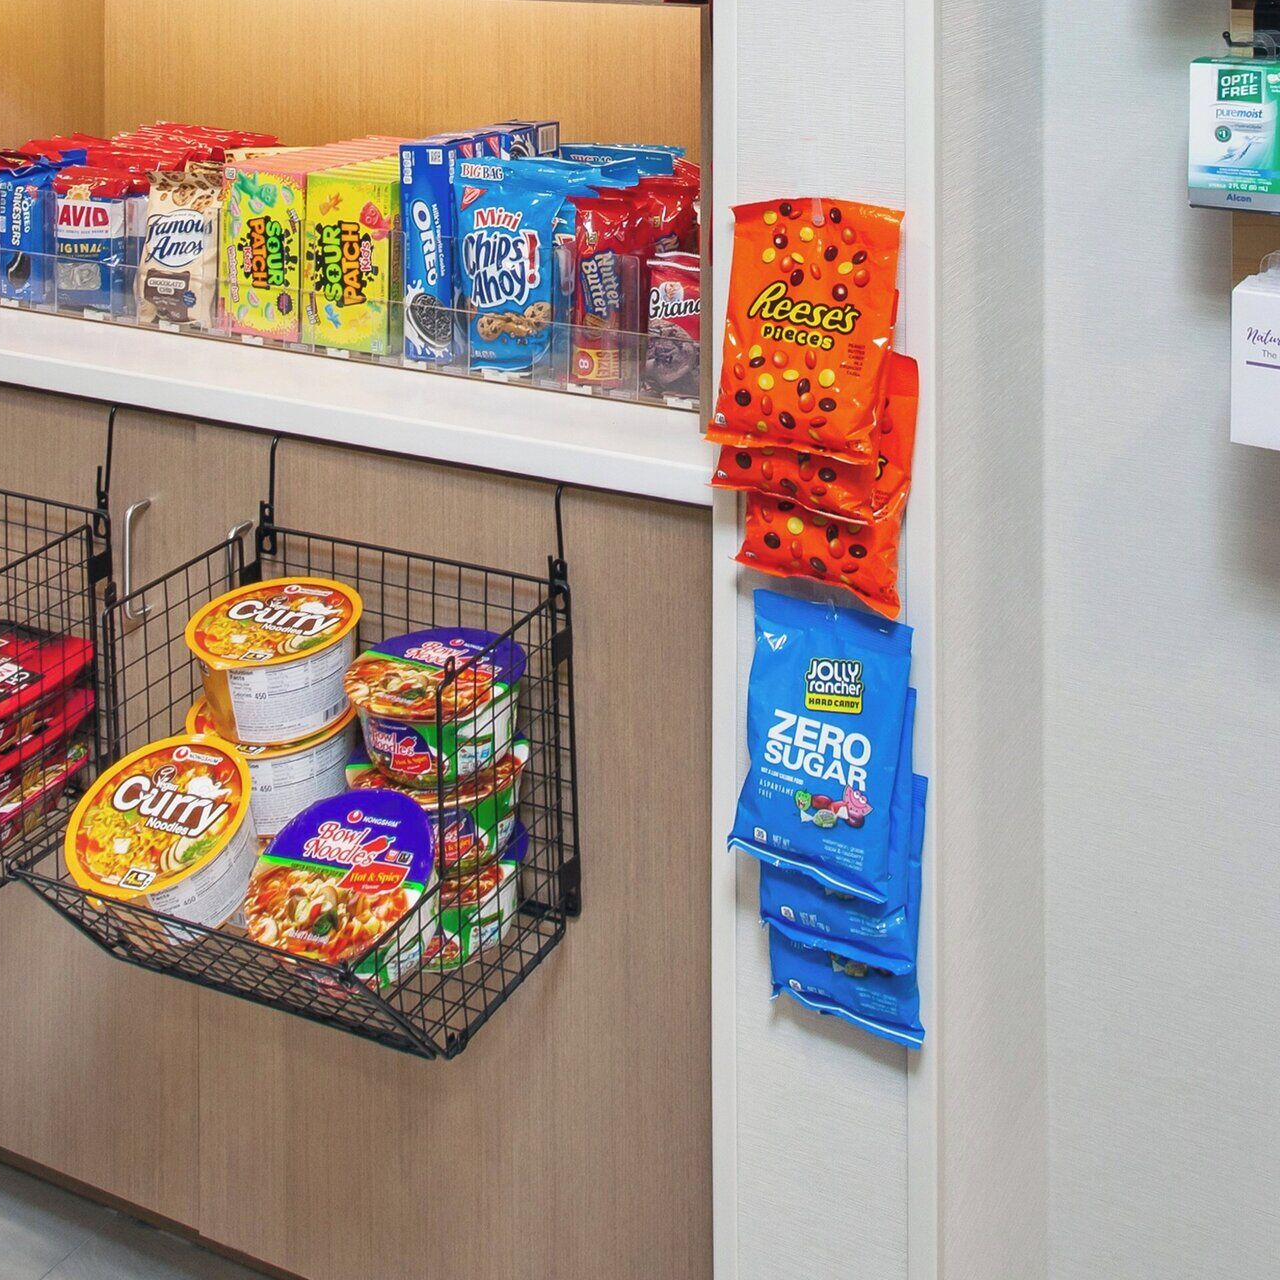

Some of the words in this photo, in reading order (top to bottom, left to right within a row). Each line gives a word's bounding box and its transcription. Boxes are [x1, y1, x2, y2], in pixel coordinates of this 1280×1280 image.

[1221, 73, 1257, 86] OPTI-
[1221, 85, 1258, 97] FREE
[1216, 109, 1262, 118] puremoist
[460, 163, 481, 178] BIG
[481, 163, 504, 180] BAG
[1226, 194, 1252, 202] Alcon
[473, 208, 522, 231] Mini
[145, 236, 203, 263] Amos
[249, 217, 270, 290] PATCH
[266, 219, 284, 286] SOUR
[411, 201, 438, 287] OREO
[463, 231, 527, 276] Chips
[324, 224, 343, 303] SOUR
[343, 221, 363, 307] PATCH
[749, 282, 860, 334] Reese's
[1262, 349, 1276, 359] The
[228, 599, 342, 637] Curry
[807, 659, 861, 682] JOLLY
[255, 692, 267, 700] 450
[808, 678, 862, 698] rancher
[808, 697, 833, 708] HARD
[833, 698, 861, 709] CANDY
[767, 709, 872, 764] ZERO
[764, 739, 867, 792] SUGAR
[112, 776, 231, 838] Curry
[147, 816, 190, 837] Noodles
[318, 822, 371, 846] Bowl
[302, 838, 377, 866] Noodles
